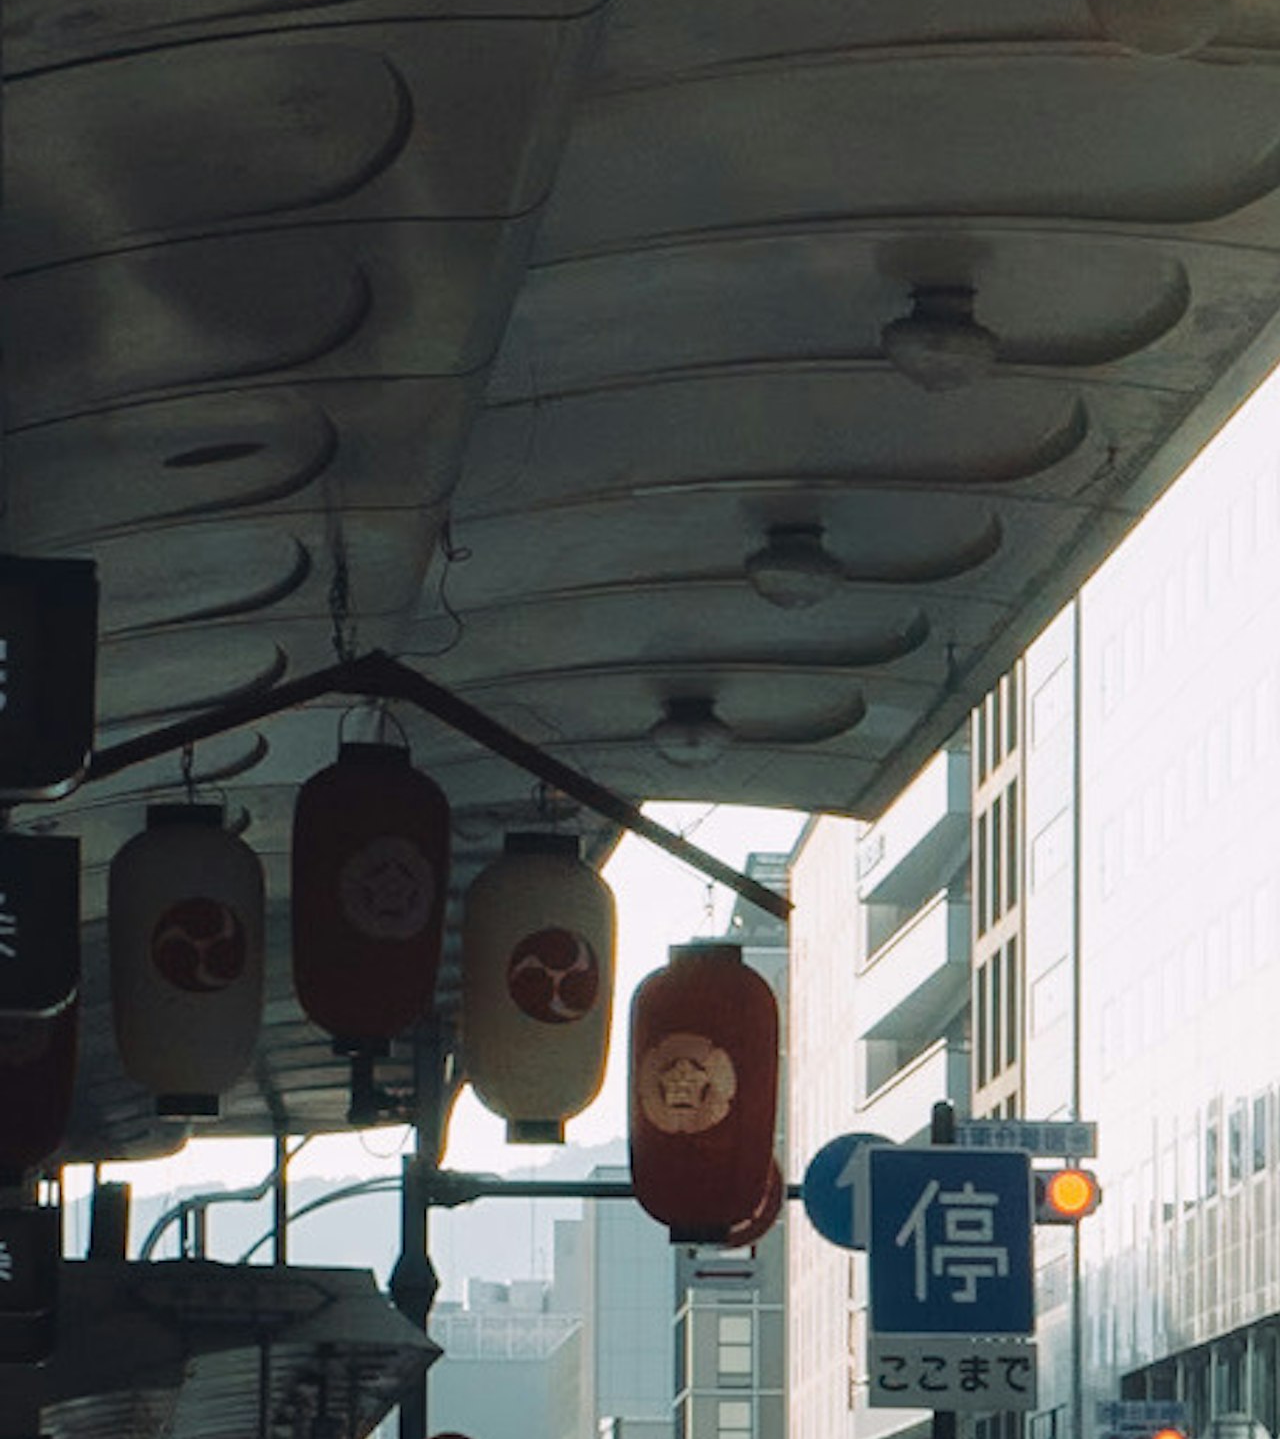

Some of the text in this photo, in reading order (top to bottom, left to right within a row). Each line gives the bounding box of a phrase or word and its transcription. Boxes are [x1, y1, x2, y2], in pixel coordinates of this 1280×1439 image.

[895, 1179, 1009, 1304] 停
[878, 1354, 1031, 1393] ここまで
